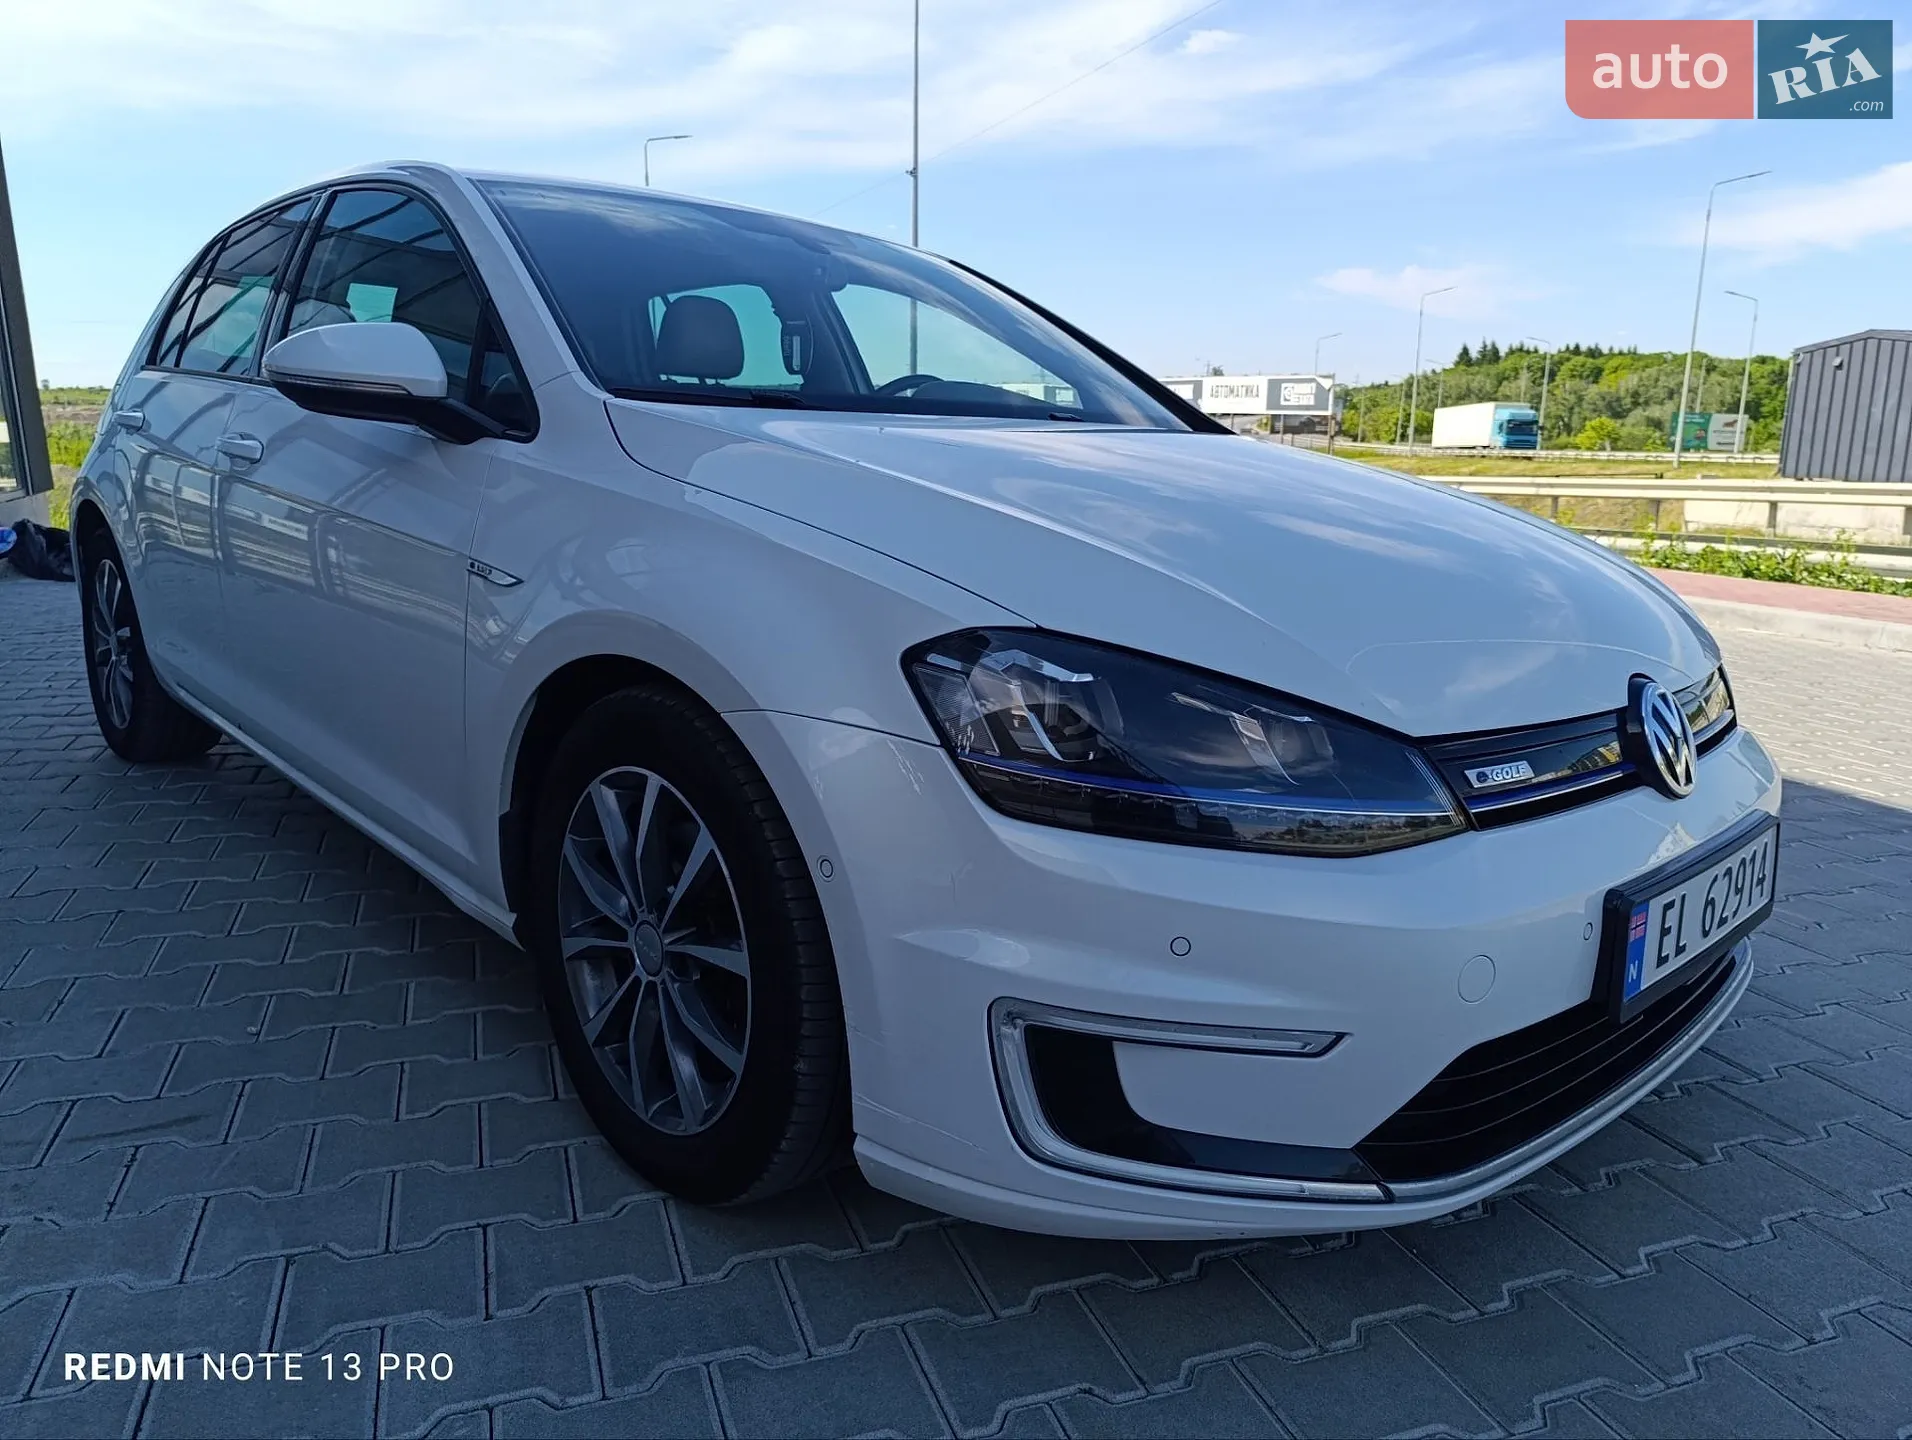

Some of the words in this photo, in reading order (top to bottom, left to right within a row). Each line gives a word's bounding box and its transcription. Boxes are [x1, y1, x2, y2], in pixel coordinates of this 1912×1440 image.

[1210, 385, 1260, 398] АВТОМАТИКА
[1656, 892, 1687, 969] EL
[1701, 840, 1768, 938] 62914
[1628, 962, 1638, 982] N
